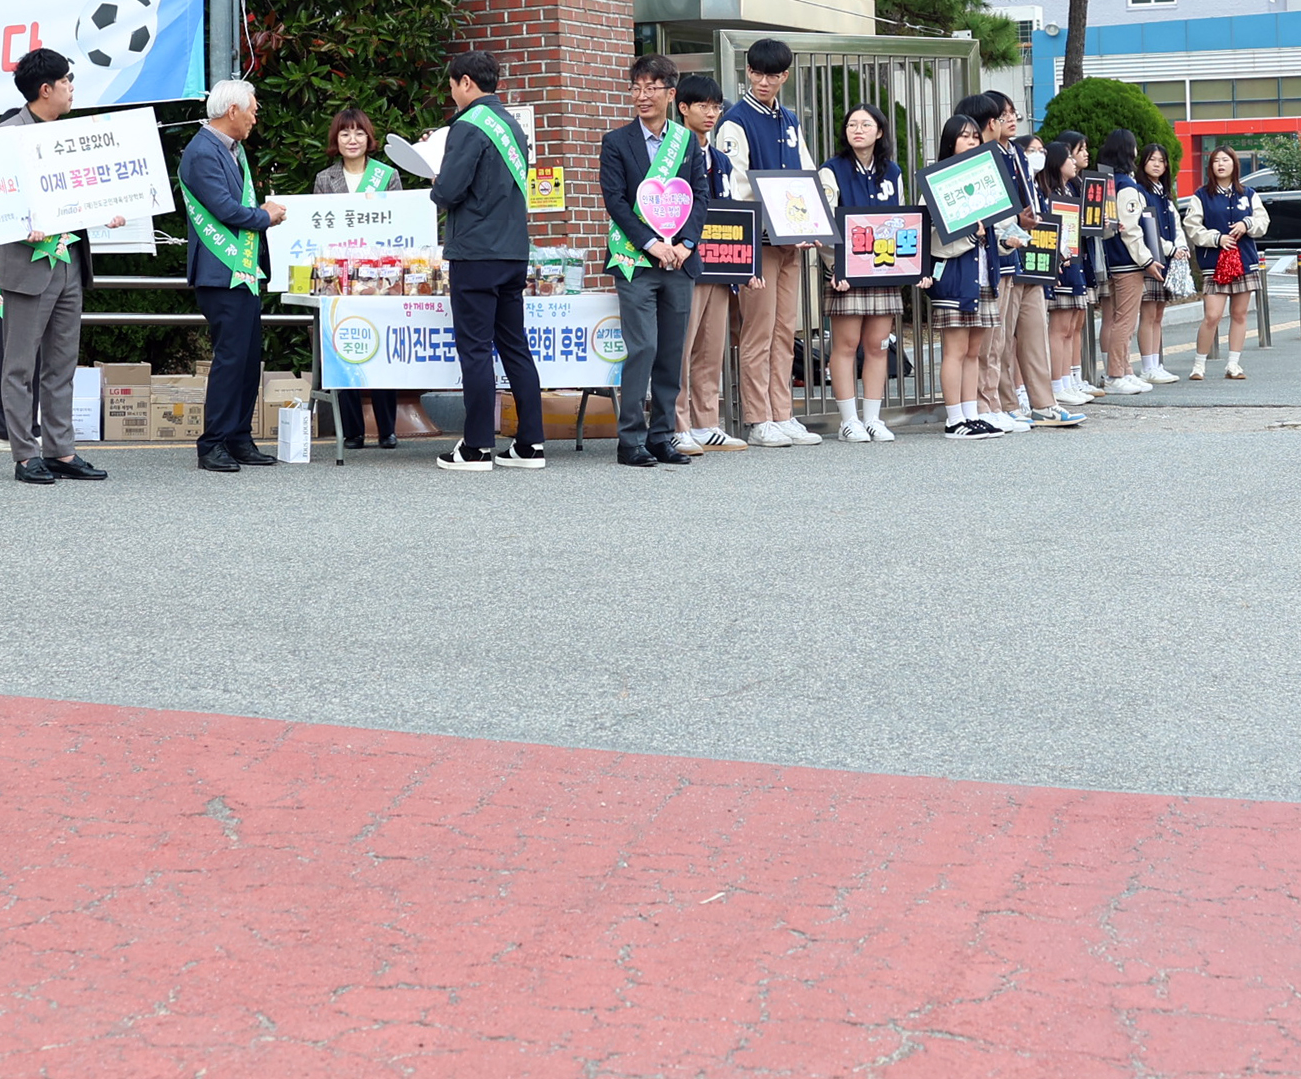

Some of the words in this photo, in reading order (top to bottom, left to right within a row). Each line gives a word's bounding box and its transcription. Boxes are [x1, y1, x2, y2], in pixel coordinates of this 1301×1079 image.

[53, 138, 77, 156] 수고
[78, 131, 120, 152] 많았어,
[40, 172, 68, 193] 이제
[69, 164, 111, 189] 꽃길만
[114, 157, 150, 180] 걷자!
[311, 210, 336, 229] 술술
[344, 210, 392, 227] 풀려라!
[548, 303, 571, 318] 정성!
[342, 341, 369, 355] 주인!
[560, 326, 588, 362] 후원
